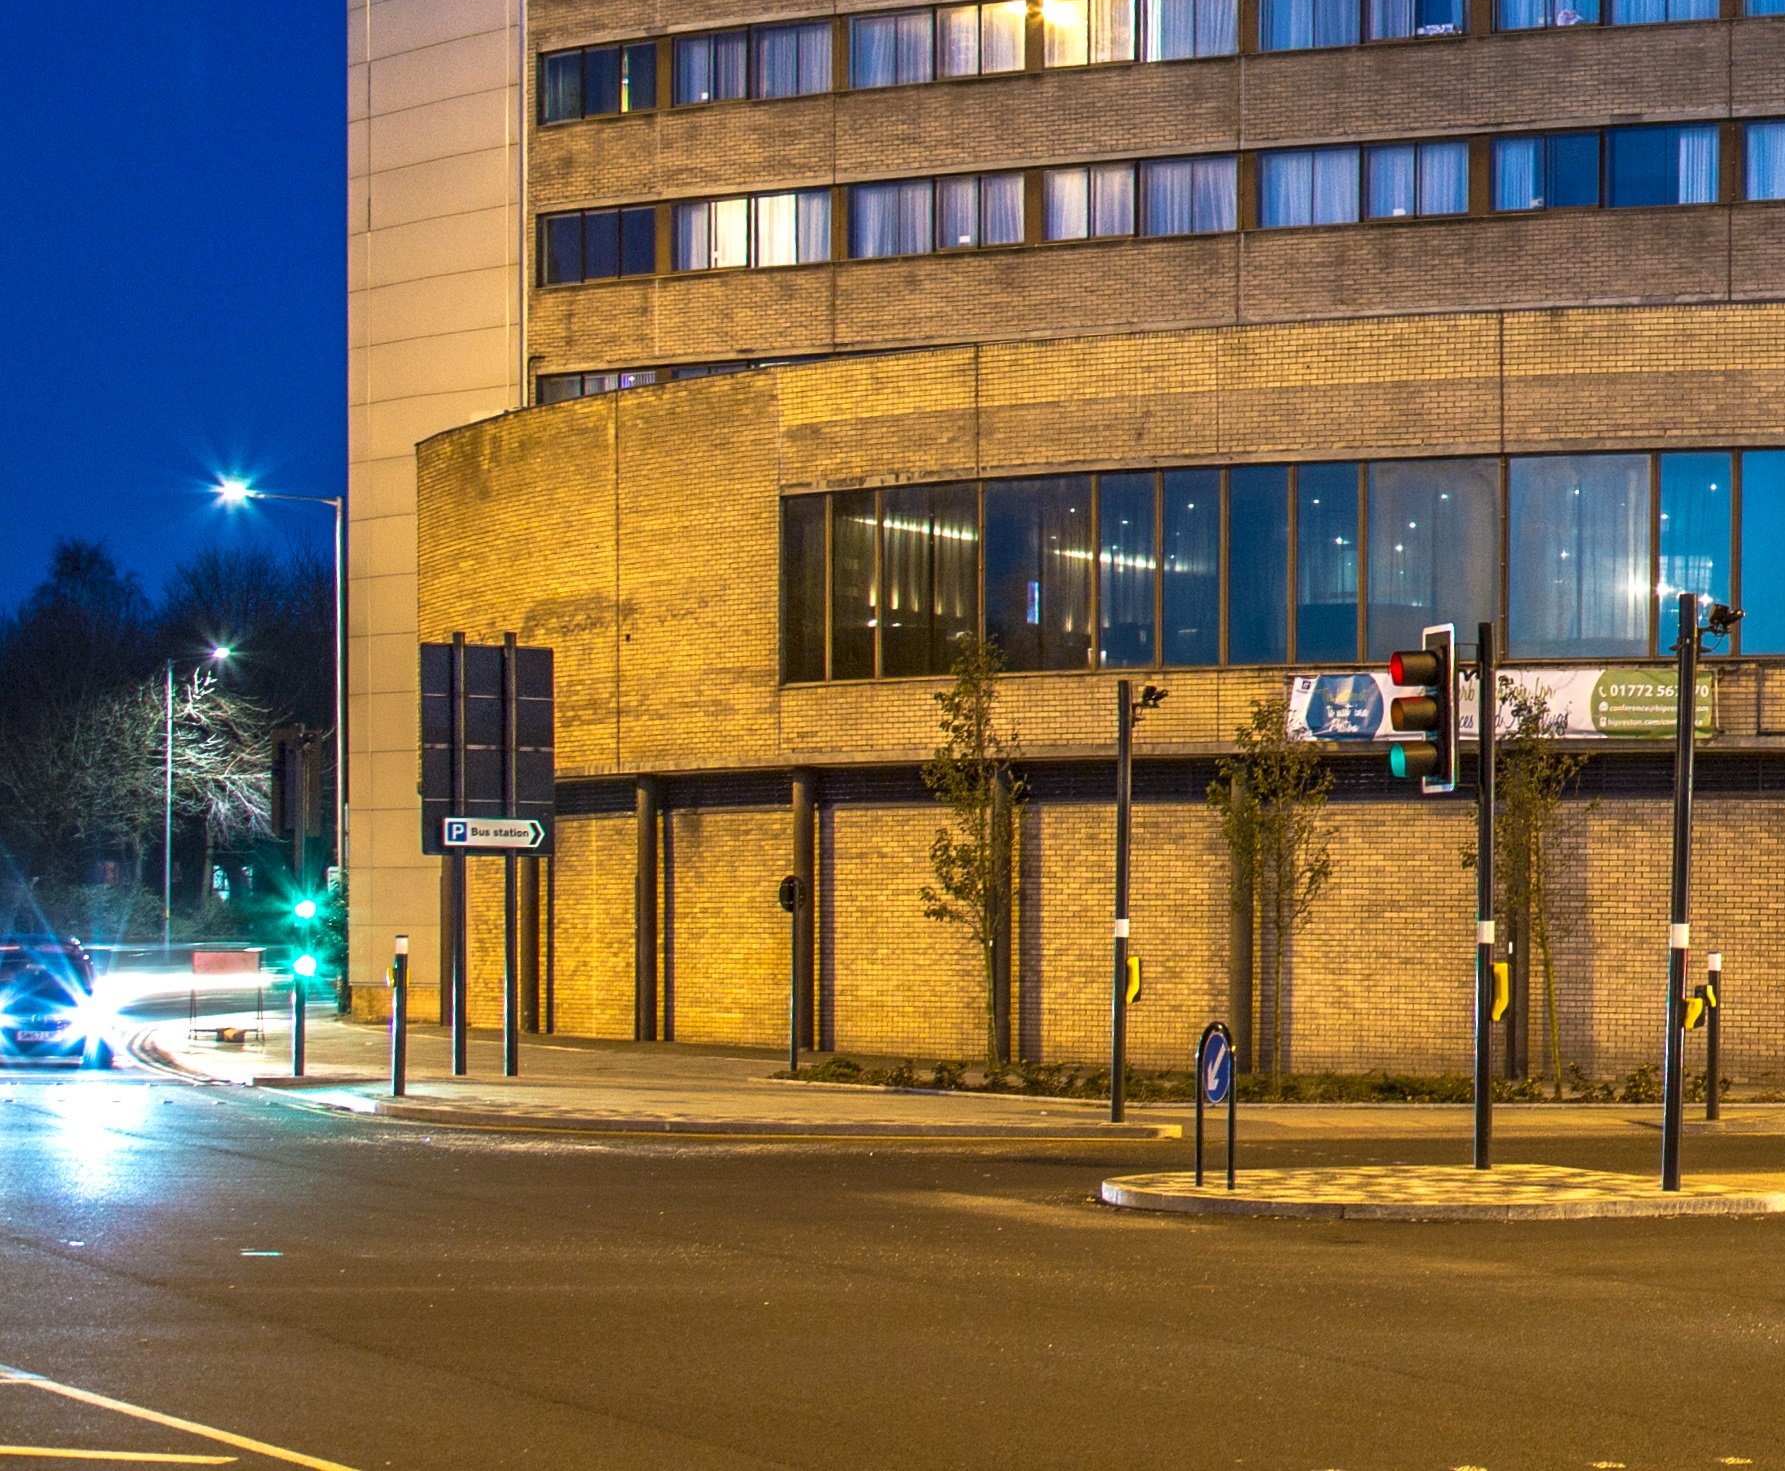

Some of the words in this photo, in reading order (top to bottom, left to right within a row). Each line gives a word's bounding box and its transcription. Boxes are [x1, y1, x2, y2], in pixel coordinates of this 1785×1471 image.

[1610, 684, 1653, 697] 01772
[471, 827, 490, 837] Bus
[493, 828, 529, 838] station
